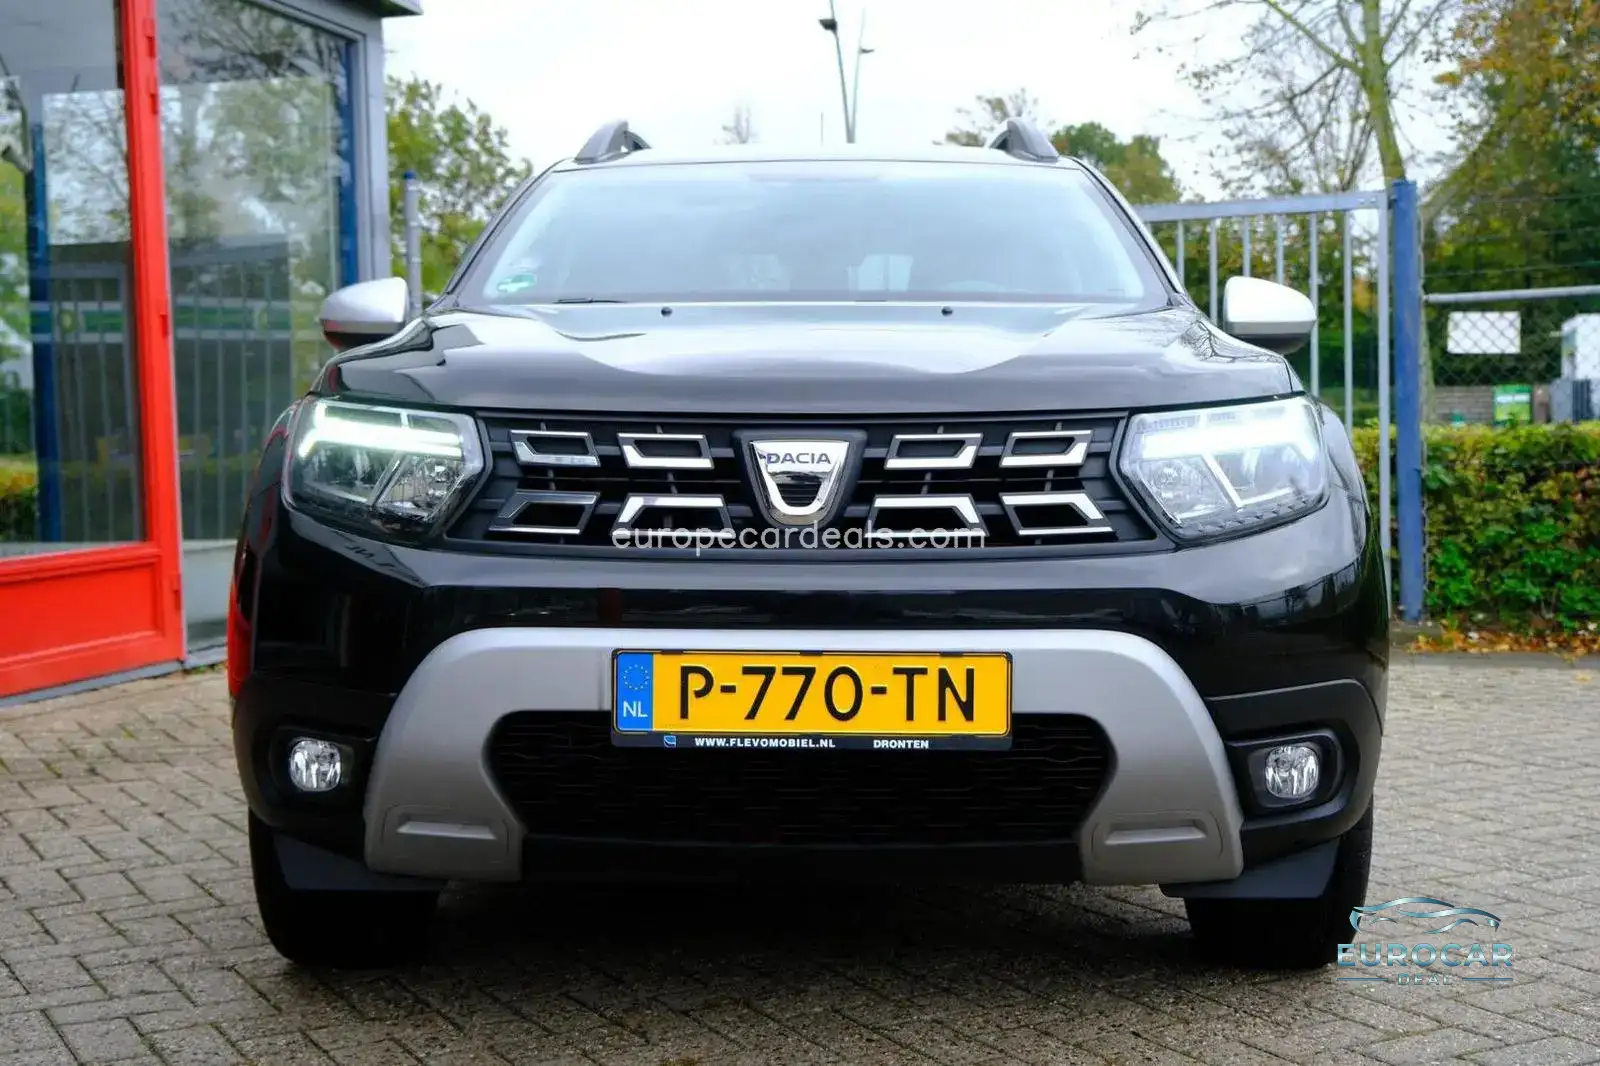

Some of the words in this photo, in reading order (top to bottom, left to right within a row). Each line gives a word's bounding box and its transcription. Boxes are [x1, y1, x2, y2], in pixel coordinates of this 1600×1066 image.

[767, 452, 831, 465] DACIA
[679, 665, 975, 722] P-770-TN
[622, 701, 648, 718] NL
[694, 736, 836, 749] WWW.FLEVOMOBIEL.NL
[873, 739, 929, 749] DRONTEN
